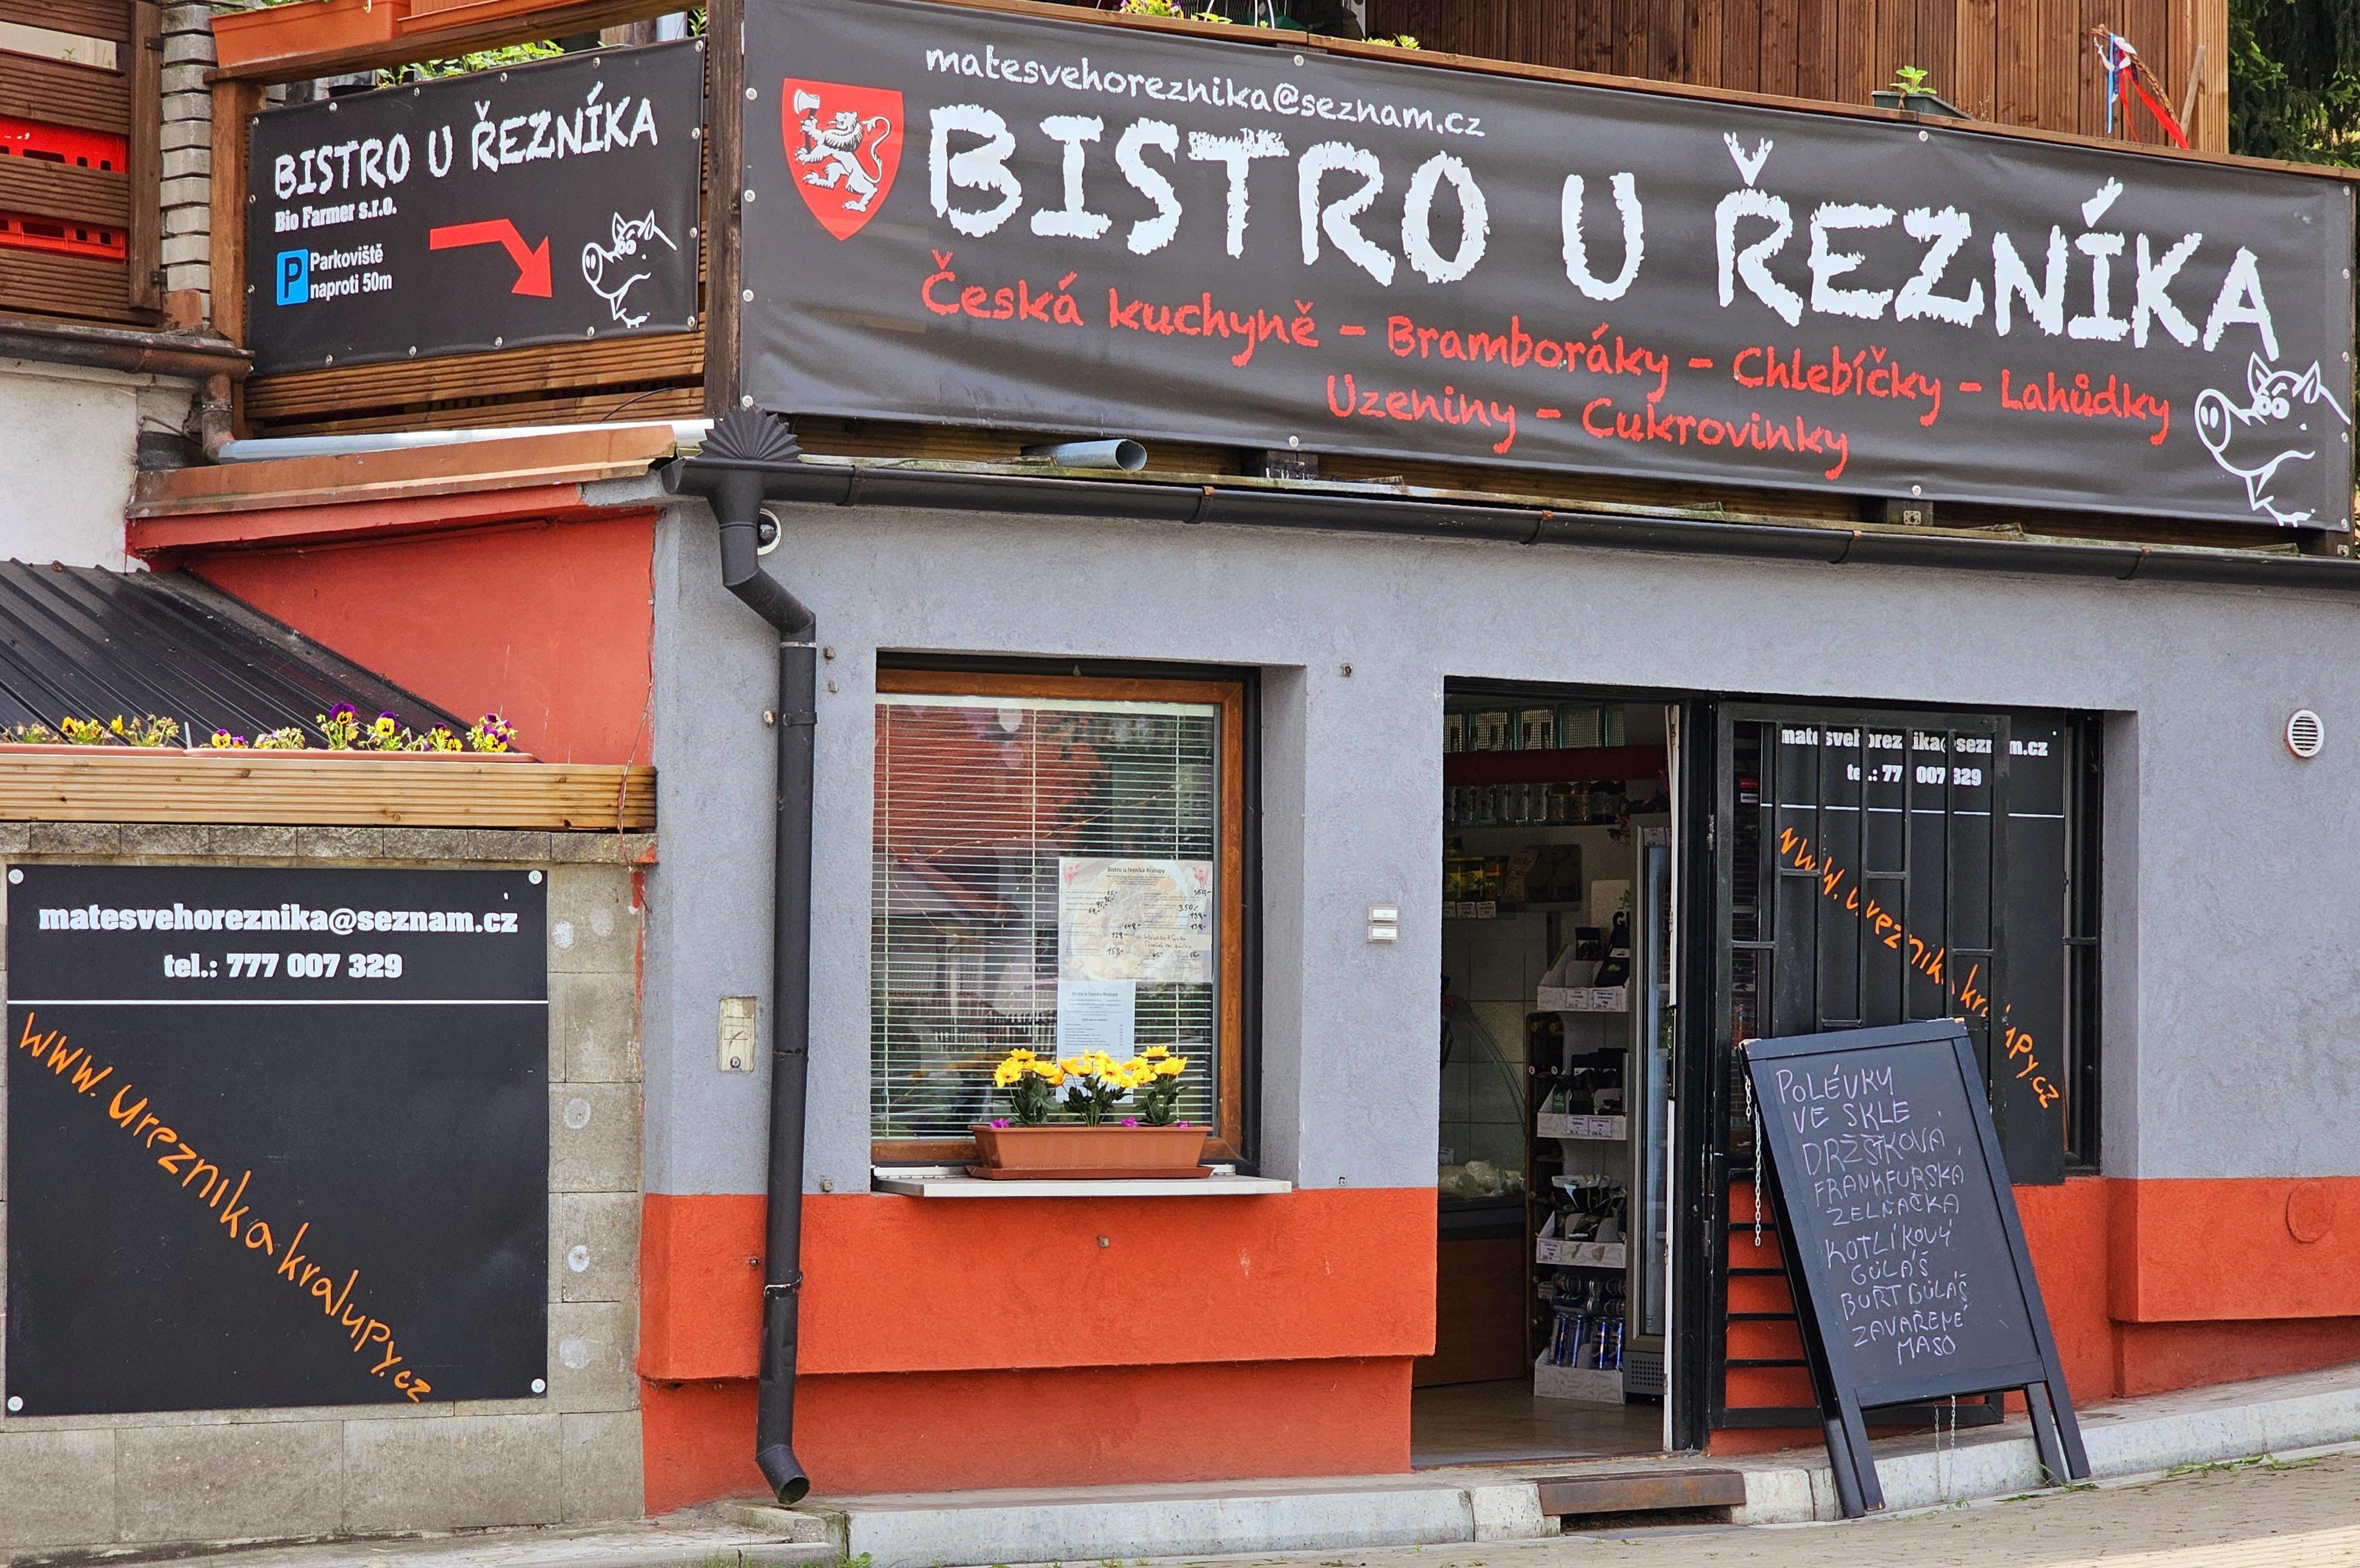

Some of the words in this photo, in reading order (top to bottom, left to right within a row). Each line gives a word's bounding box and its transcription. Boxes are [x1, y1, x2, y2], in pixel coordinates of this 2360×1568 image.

[926, 45, 1485, 137] matesvehoreznika@seznam.cz
[276, 133, 410, 199] BISTRO
[429, 125, 452, 177] U
[472, 81, 657, 172] ŘEZNÍKA
[275, 210, 299, 233] Bio
[303, 203, 355, 228] Farmer
[359, 197, 397, 219] s.r.o.
[928, 104, 1490, 287] BISTRO
[1562, 172, 1645, 301] U
[1715, 131, 2279, 362] ŘEZNÍKA
[310, 243, 383, 271] Parkoviště
[284, 257, 303, 299] P
[310, 274, 359, 301] naproti
[363, 272, 393, 293] 50m
[921, 250, 1083, 326] Česká
[1109, 288, 1319, 366] kuchyně
[1388, 316, 1669, 403] Bramboráky
[1733, 345, 1942, 427] Chlebíčky
[2001, 368, 2170, 446] Lahůdky
[1327, 374, 1516, 455] Uzeniny
[1582, 397, 1849, 480] Cukrovinky
[1848, 764, 1878, 782] te.:
[39, 904, 519, 935] matesvehoreznika@seznam.cz
[164, 953, 217, 978] tel.:
[227, 953, 279, 978] 777
[287, 953, 340, 978] 007
[349, 954, 403, 979] 329
[1793, 1107, 1829, 1134] VE
[1843, 1100, 1910, 1131] SKLE
[1898, 1335, 1956, 1365] MASO
